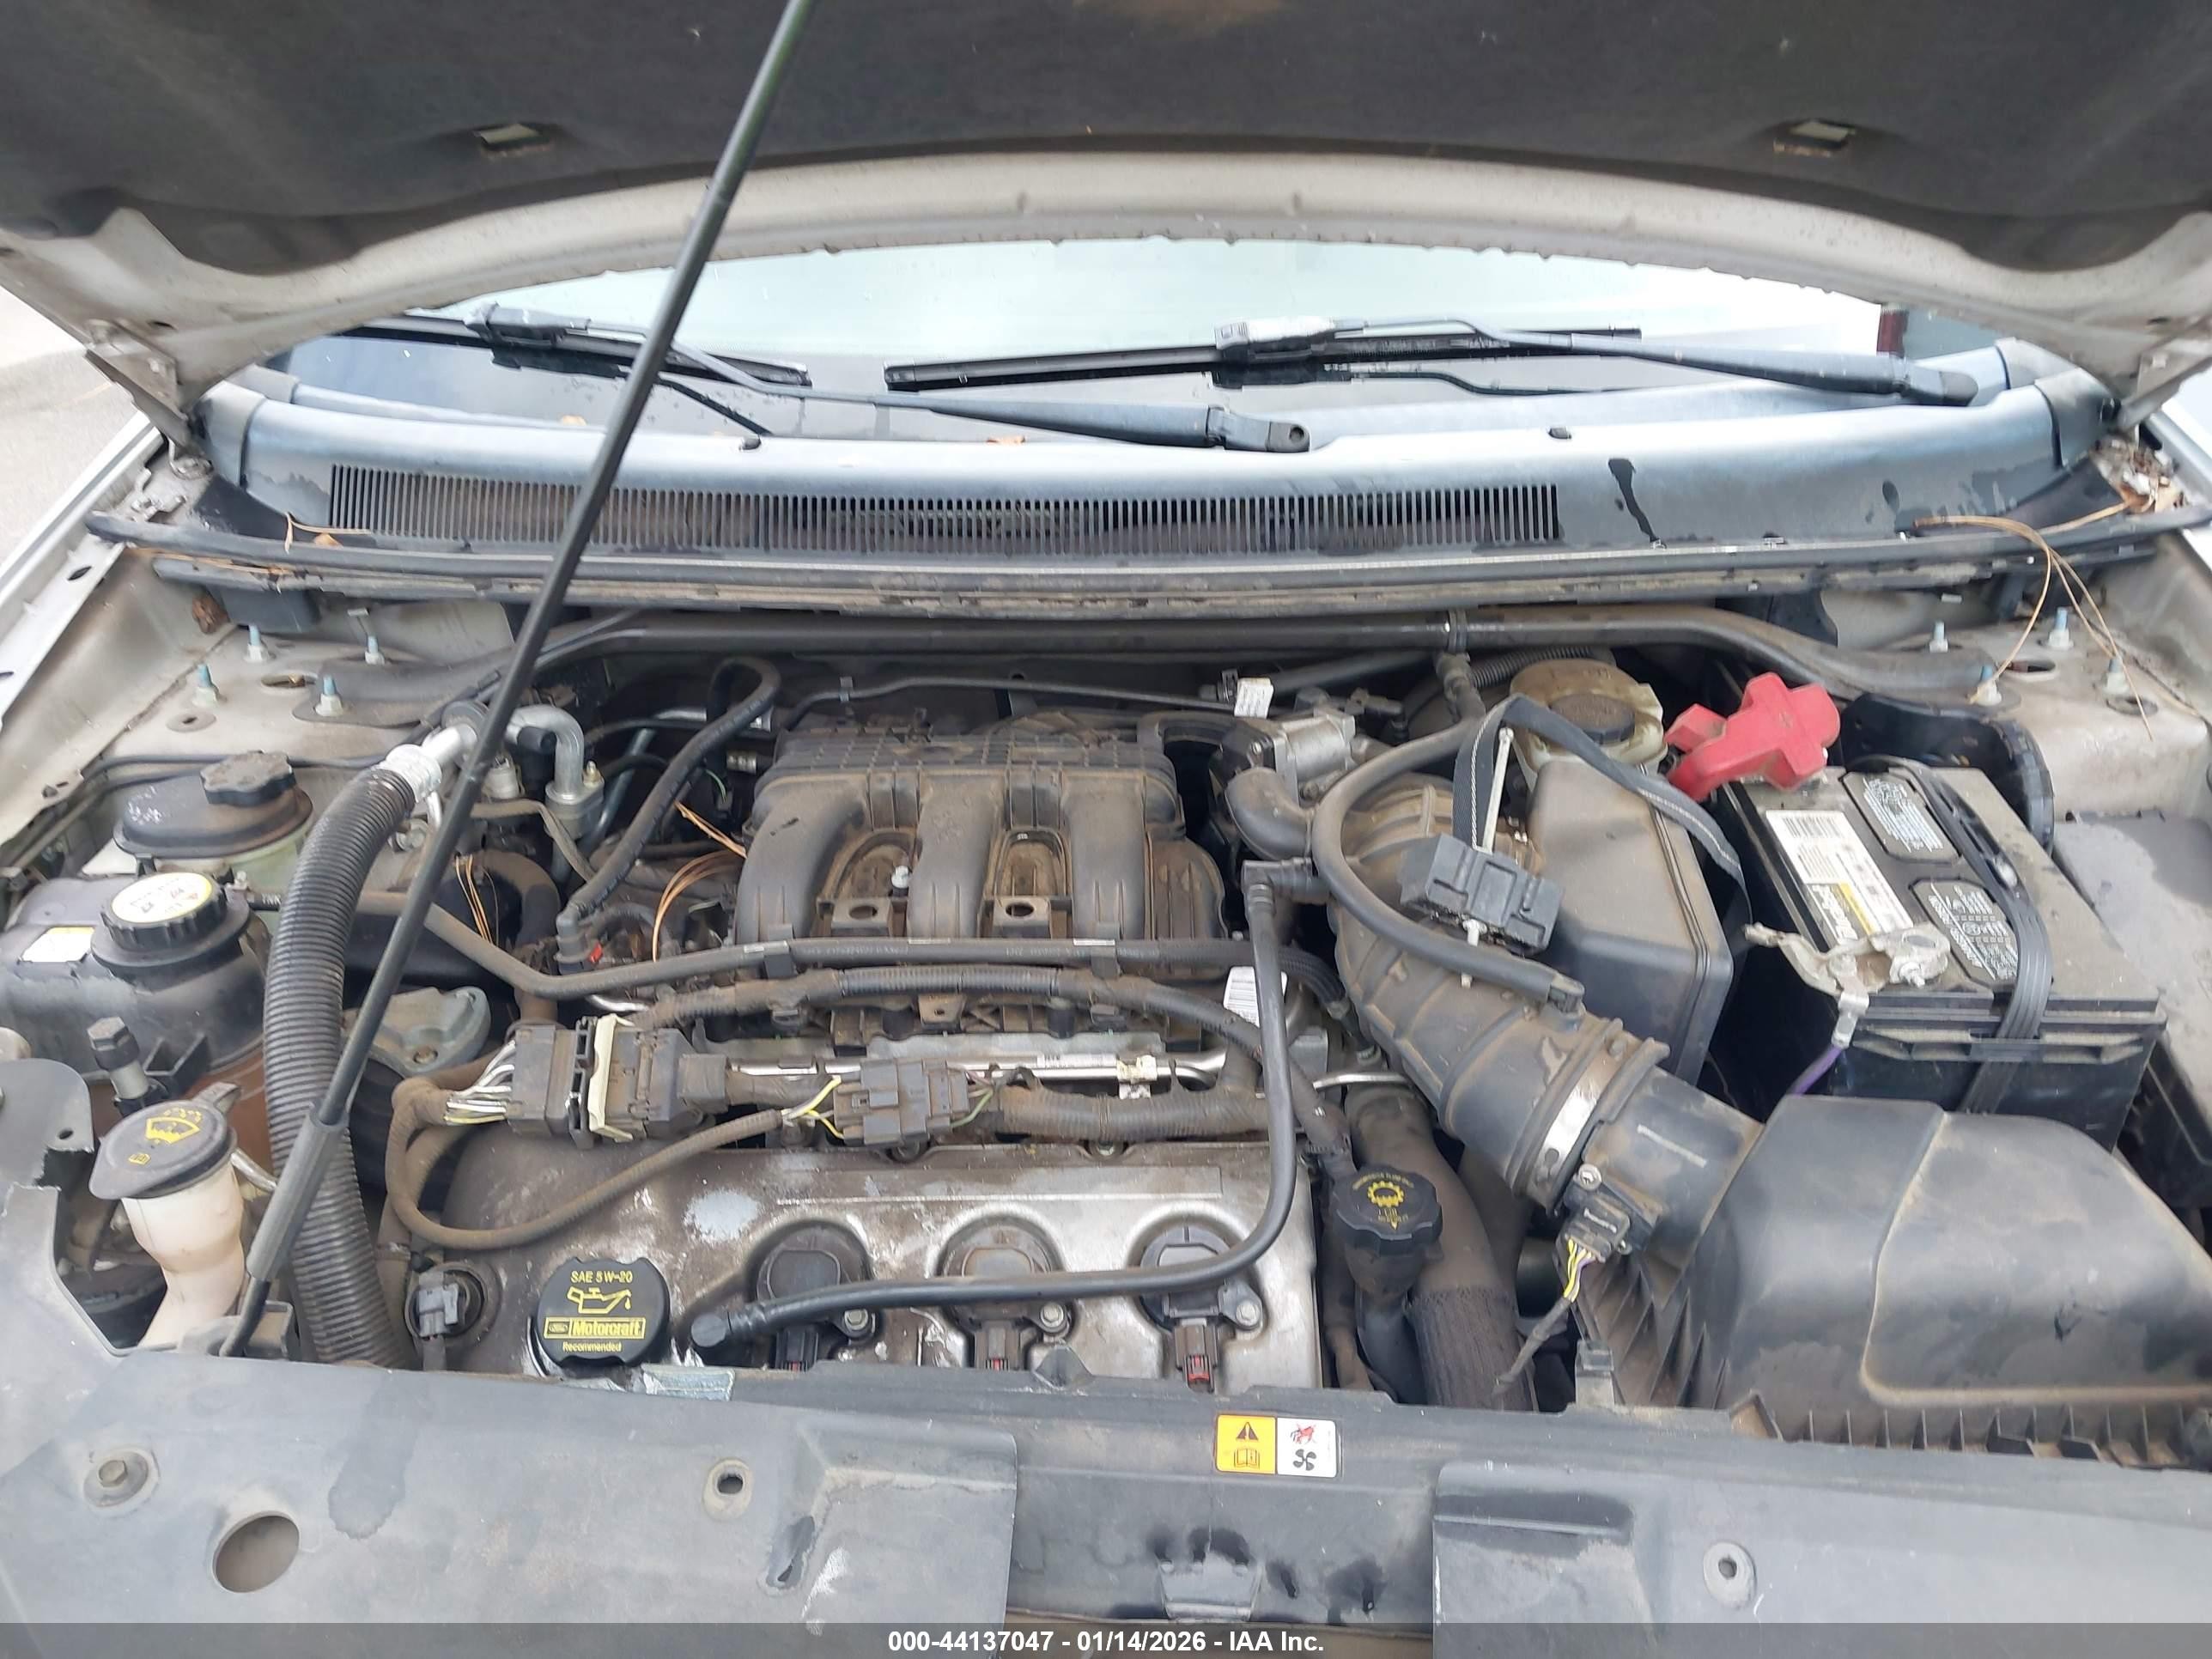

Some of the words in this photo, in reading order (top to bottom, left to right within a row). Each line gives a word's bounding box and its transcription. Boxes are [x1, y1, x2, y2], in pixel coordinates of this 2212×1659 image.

[570, 1270, 593, 1283] SAE
[572, 1318, 641, 1336] Motorcraft
[562, 1341, 623, 1352] Recommended
